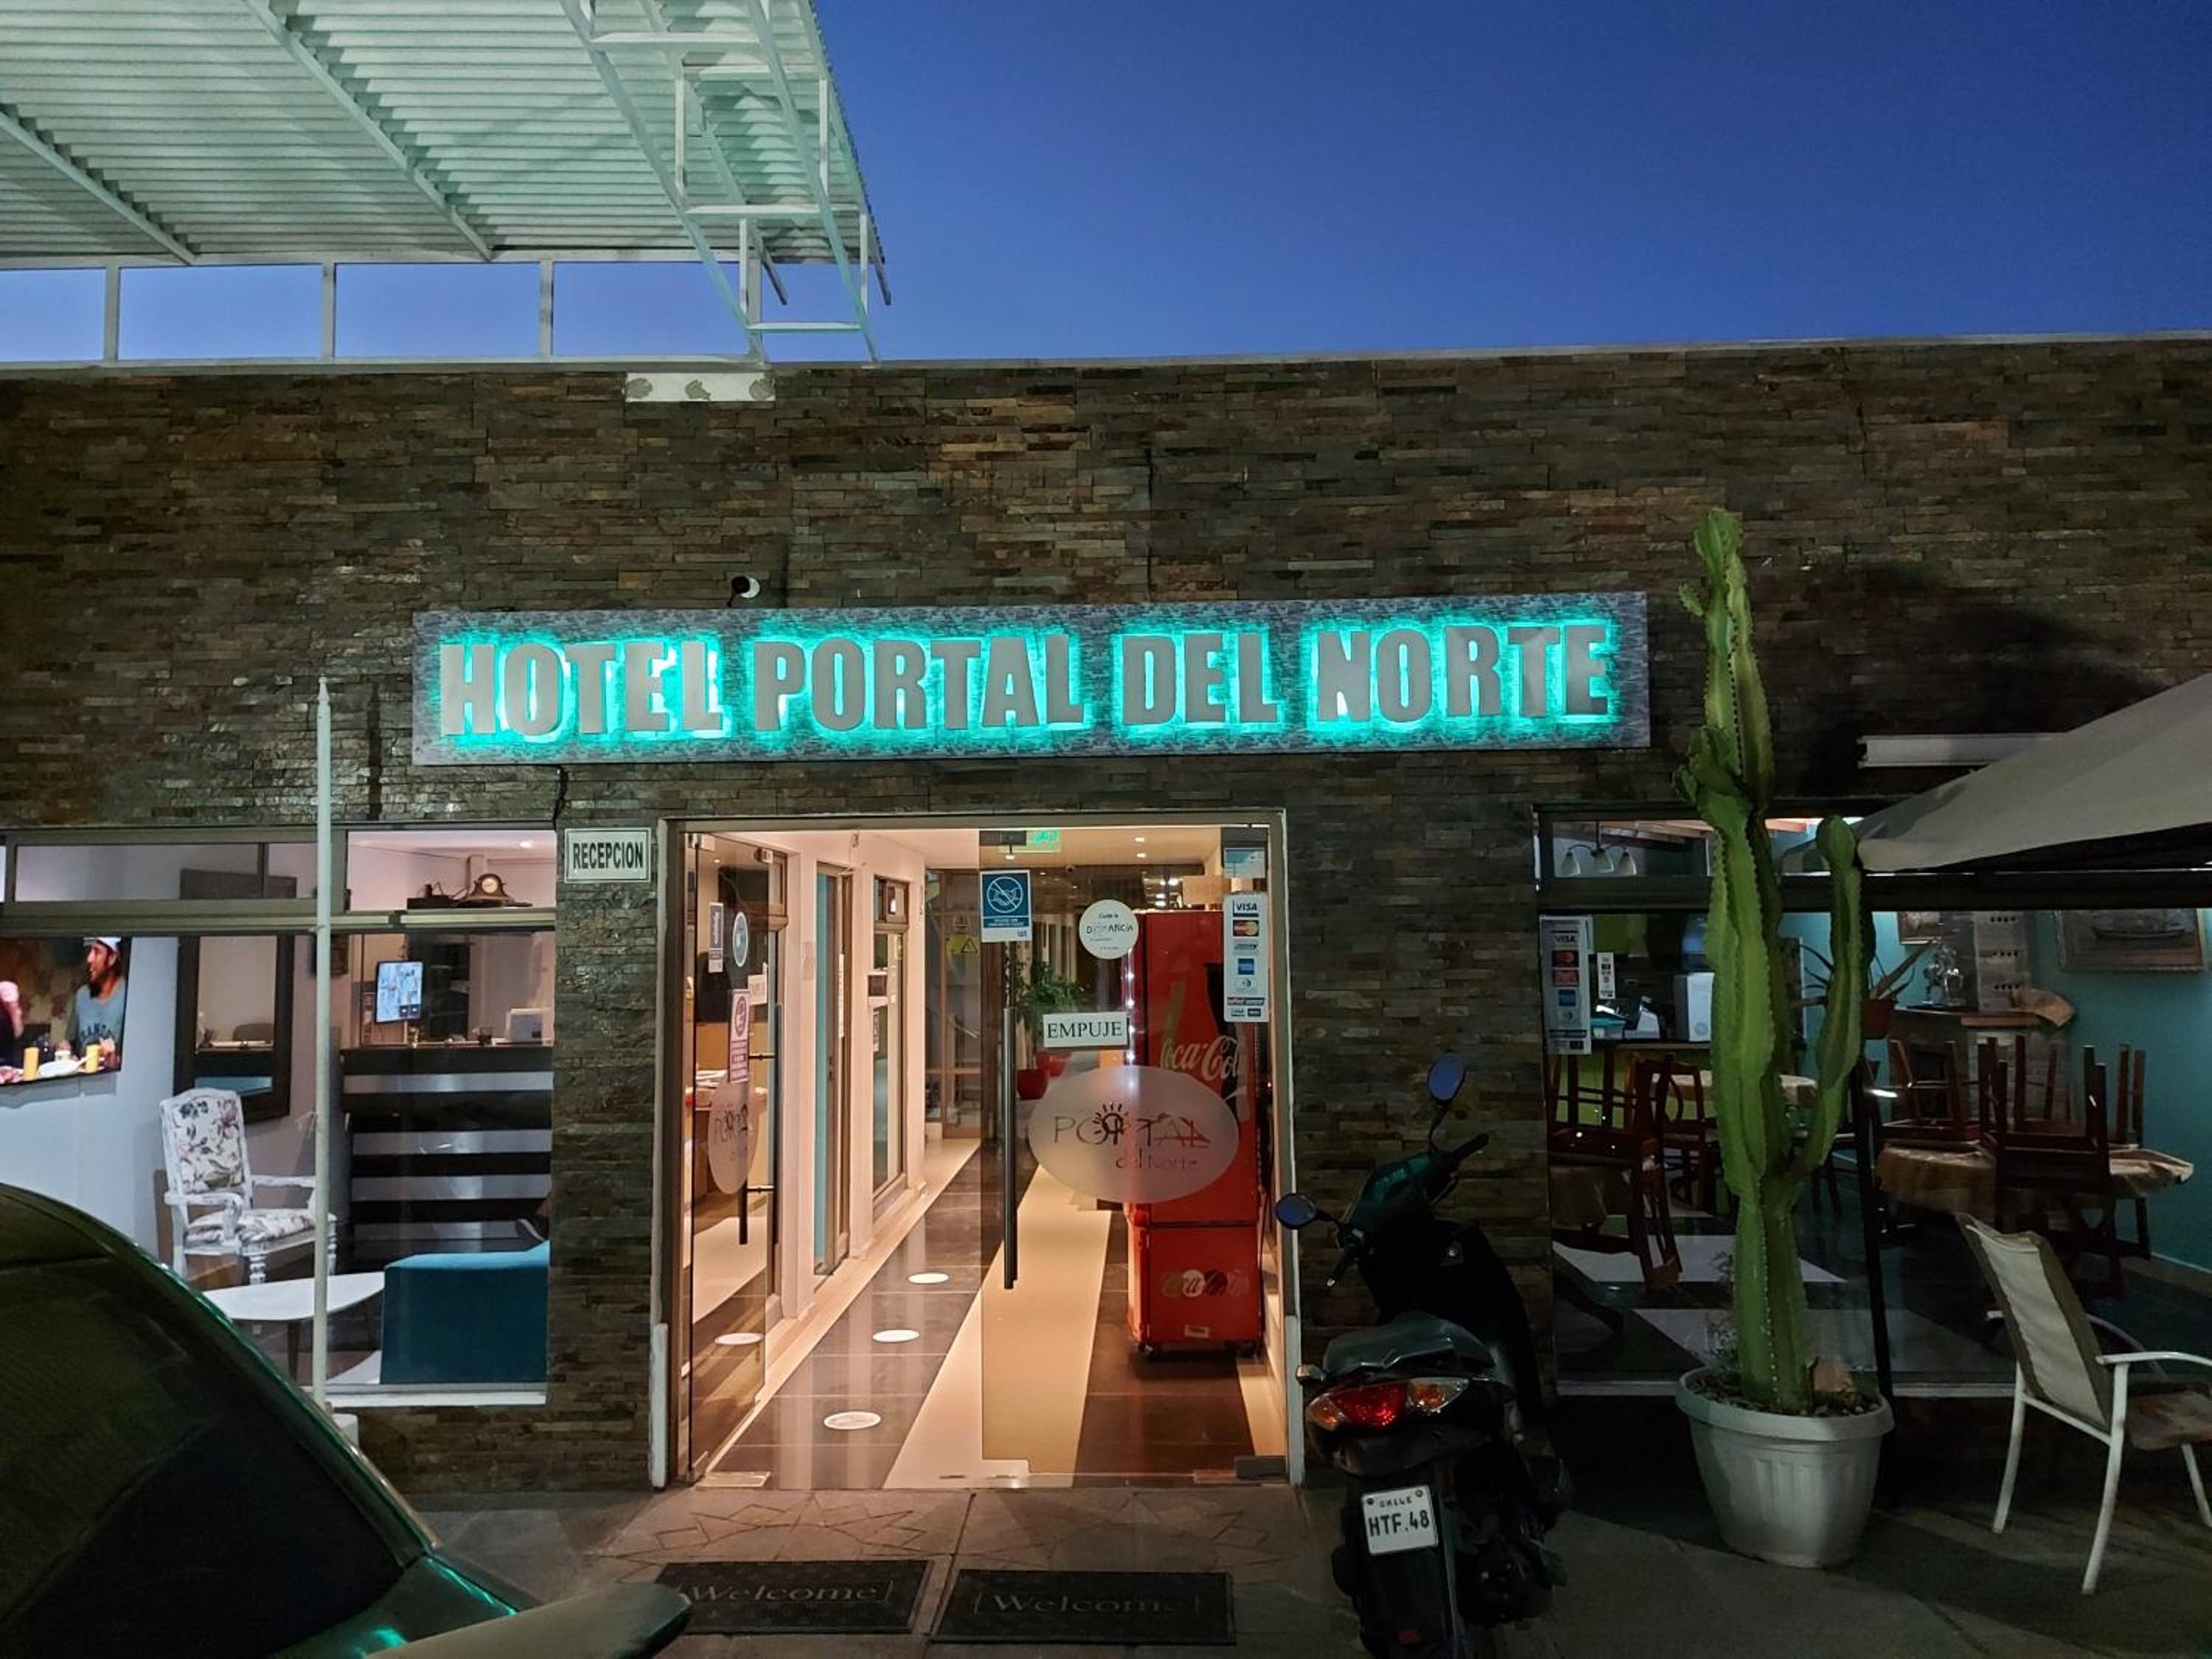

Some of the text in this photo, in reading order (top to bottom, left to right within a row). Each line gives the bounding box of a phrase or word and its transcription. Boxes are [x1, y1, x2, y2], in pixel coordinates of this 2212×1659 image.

[442, 625, 1608, 736] HOTEL PORTAL DEL NORTE
[573, 841, 644, 869] RECEPCION
[1237, 902, 1258, 911] VISA
[1556, 934, 1576, 943] VISA
[1047, 1021, 1123, 1038] EMPUJE
[1160, 1034, 1240, 1082] Coca-Col
[1380, 1496, 1413, 1508] CHILE
[1368, 1510, 1430, 1537] HTF.48
[689, 1585, 879, 1604] Welcome
